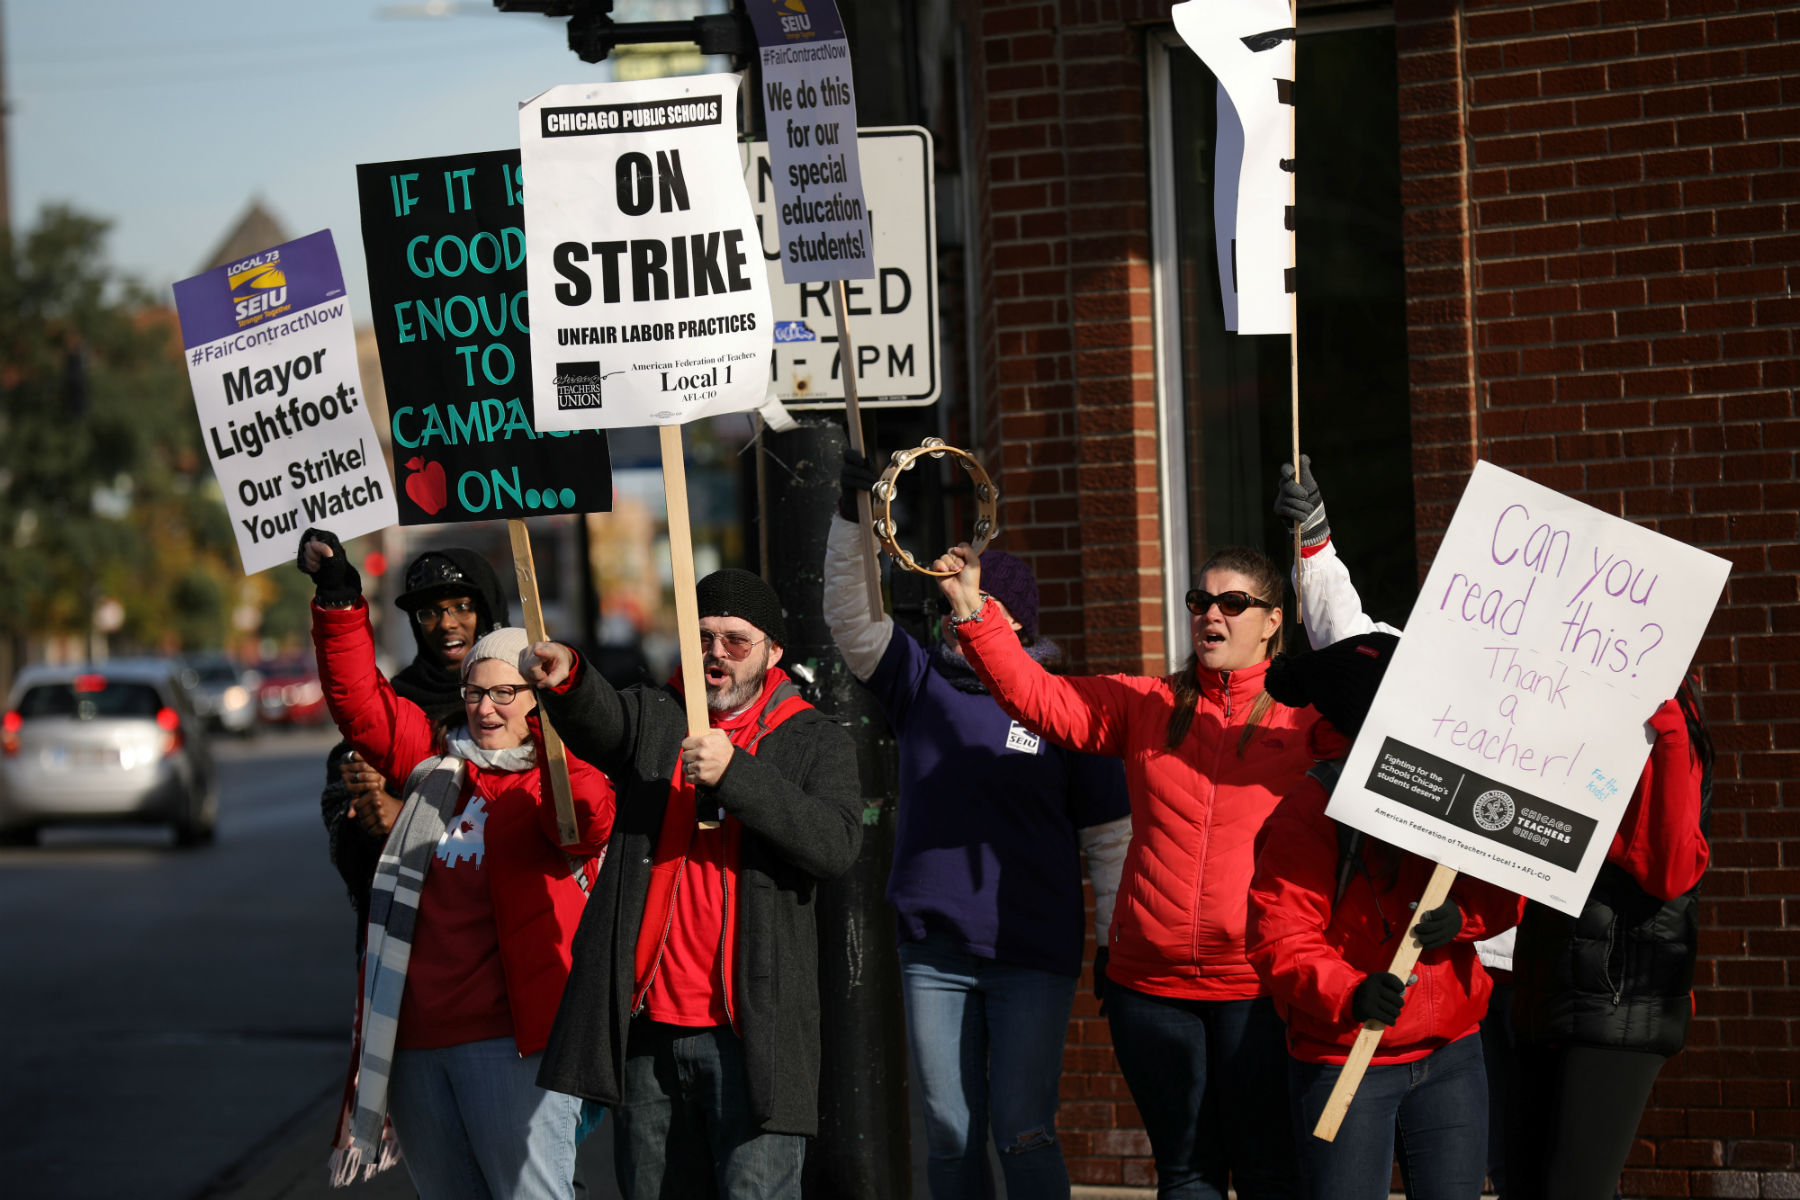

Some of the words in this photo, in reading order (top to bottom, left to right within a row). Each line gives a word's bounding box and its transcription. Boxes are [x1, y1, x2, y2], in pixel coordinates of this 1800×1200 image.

[781, 14, 811, 33] SEIU
[763, 43, 846, 66] #FairContractNow
[767, 81, 792, 112] We
[797, 79, 817, 109] do
[820, 76, 850, 107] this
[547, 111, 619, 132] CHICAGO
[622, 107, 666, 128] PUBLIC
[667, 102, 718, 124] SCHOOLS
[786, 118, 810, 148] for
[815, 122, 840, 146] our
[615, 149, 691, 217] ON
[788, 153, 848, 193] special
[390, 172, 420, 217] IF
[444, 168, 476, 214] IT
[782, 192, 863, 225] education
[227, 256, 263, 276] LOCAL
[265, 250, 280, 263] 73
[406, 226, 526, 279] GOOD
[788, 229, 866, 264] students!
[553, 228, 752, 307] STRIKE
[236, 286, 287, 321] SEIU
[191, 304, 344, 366] #FairContractNow
[557, 326, 617, 346] UNFAIR
[621, 322, 675, 344] LABOR
[678, 313, 757, 341] PRACTICES
[222, 349, 327, 405] Mayor
[456, 343, 516, 387] TO
[631, 361, 673, 371] American
[675, 356, 716, 368] Federation
[717, 355, 725, 364] of
[727, 352, 756, 362] Teachers
[558, 384, 601, 395] TEACHERS
[661, 367, 718, 392] Local
[725, 365, 733, 384] 1
[559, 393, 601, 407] UNION
[682, 390, 718, 402] AFL-CIO
[211, 382, 359, 460] Lightfoot:
[392, 397, 600, 449] CAMPA
[238, 474, 282, 507] Our
[242, 508, 298, 544] Your
[302, 476, 384, 523] Watch
[1491, 504, 1570, 579] Can
[1567, 546, 1658, 608] you
[1439, 572, 1537, 636] read
[1560, 601, 1664, 679] this?
[1483, 645, 1570, 709] Thank
[1499, 693, 1517, 725] a
[1008, 735, 1037, 748] SEIU
[1432, 705, 1585, 786] teacher!
[1381, 763, 1411, 780] schools
[1411, 775, 1449, 795] Chicago's
[1384, 753, 1416, 773] Fighting
[1416, 767, 1430, 777] for
[1430, 772, 1443, 783] the
[1377, 772, 1410, 789] students
[1410, 785, 1441, 802] deserve
[1513, 826, 1550, 847] UNION
[1517, 816, 1572, 844] TEACHERS
[1521, 807, 1573, 833] CHICAGO
[1374, 807, 1408, 826] American
[1409, 821, 1447, 841] Federation
[1457, 840, 1487, 857] Teachers
[1492, 854, 1512, 867] Local
[1521, 865, 1551, 882] AFL-CIO
